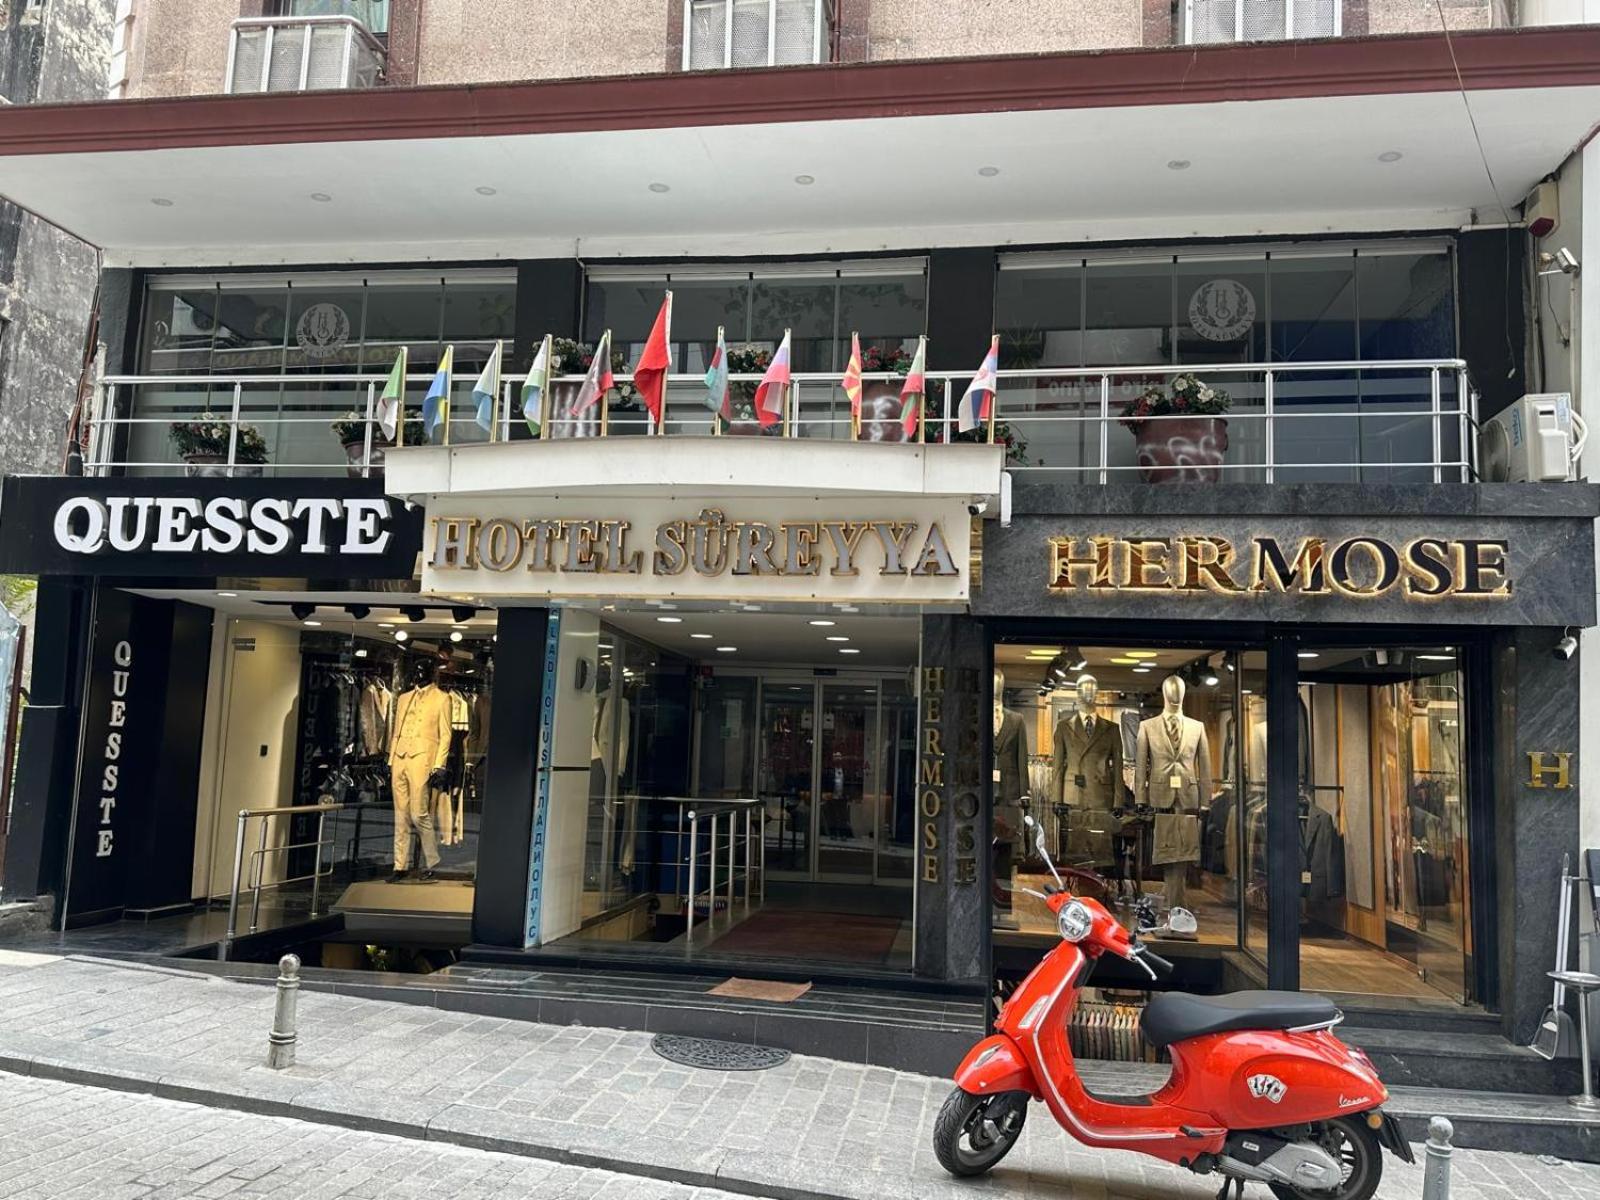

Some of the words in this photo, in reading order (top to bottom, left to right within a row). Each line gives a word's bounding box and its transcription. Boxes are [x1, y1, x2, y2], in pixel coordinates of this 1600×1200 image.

[53, 496, 393, 555] QUESSTE
[430, 516, 643, 574] HOTEL
[652, 508, 961, 577] SÜREYYA
[1047, 534, 1514, 599] HERMOSE
[96, 640, 132, 857] QUESSTE
[921, 666, 945, 884] HERMOSE
[1525, 751, 1574, 790] H
[528, 778, 546, 939] ГЛАДИОЛУС
